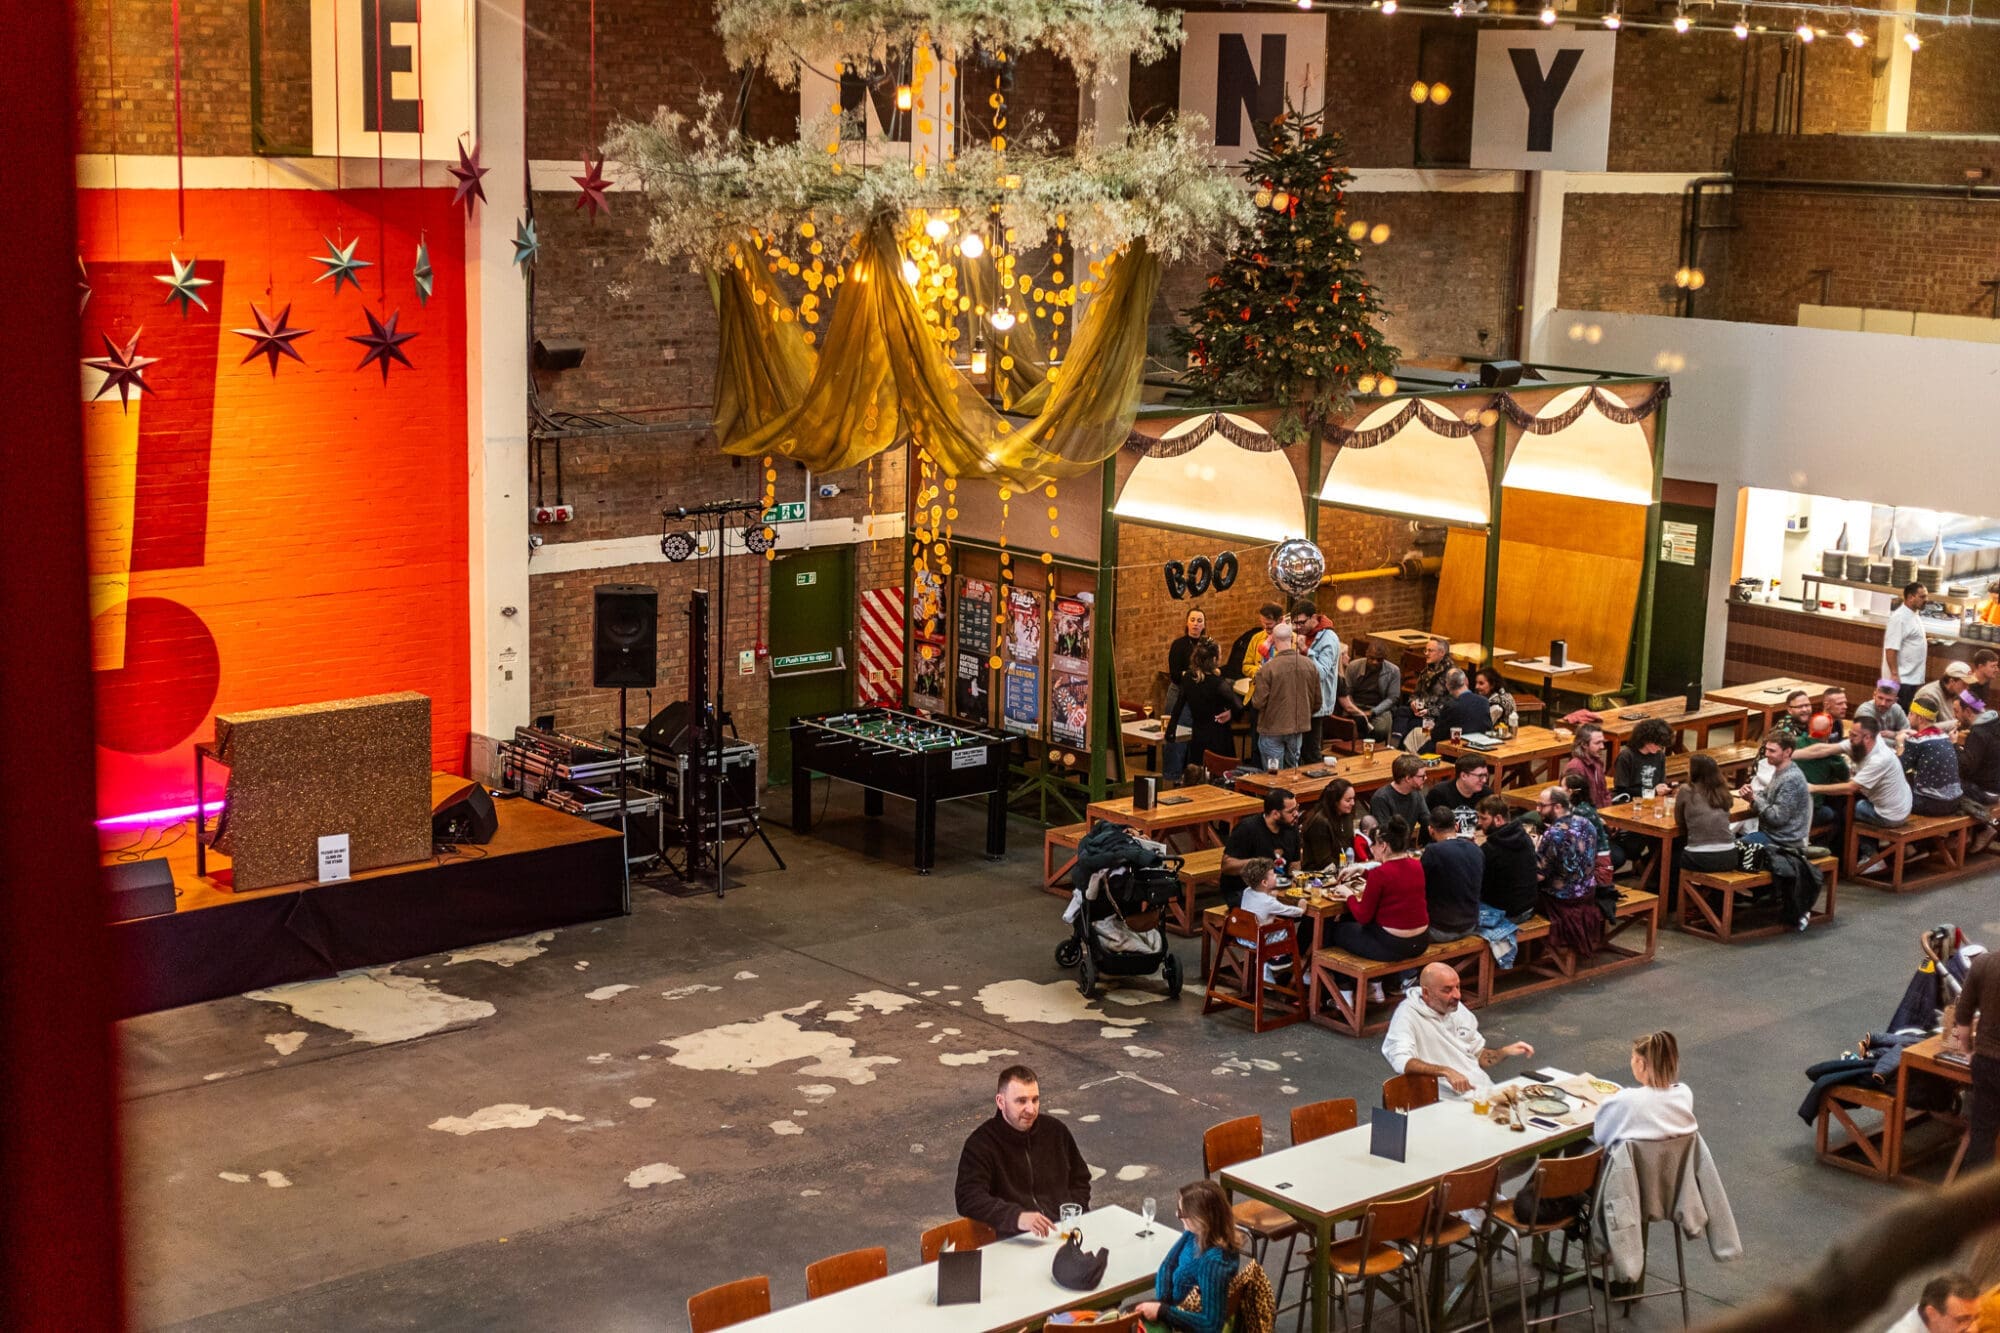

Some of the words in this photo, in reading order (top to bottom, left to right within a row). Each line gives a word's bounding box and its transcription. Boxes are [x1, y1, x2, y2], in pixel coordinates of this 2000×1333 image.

[361, 0, 424, 133] E
[1215, 33, 1287, 147] N
[1507, 48, 1585, 152] Y
[1164, 550, 1239, 600] BOO
